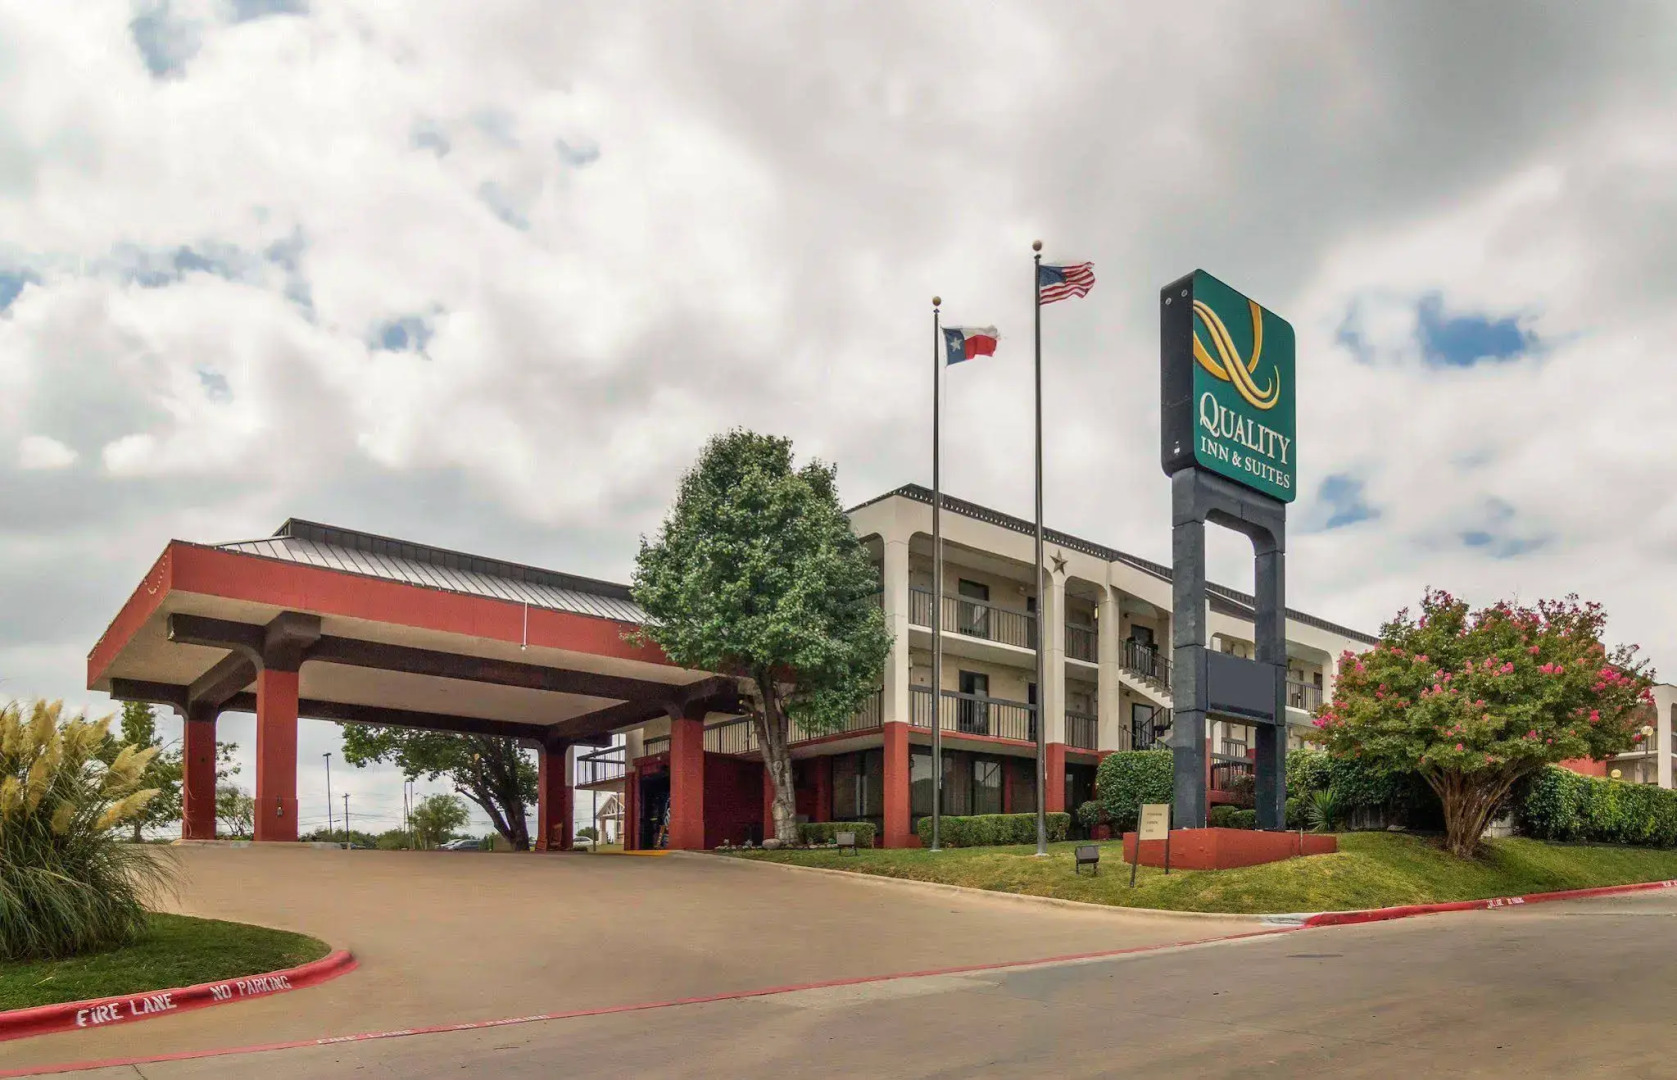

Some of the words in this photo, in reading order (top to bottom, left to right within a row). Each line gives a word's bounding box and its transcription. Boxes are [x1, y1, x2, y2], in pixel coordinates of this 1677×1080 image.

[1199, 391, 1291, 465] QUALITY
[1200, 435, 1230, 463] INN
[1231, 450, 1243, 468] &
[1244, 456, 1291, 489] SUITES
[76, 1002, 124, 1027] FIRE
[129, 993, 178, 1016] LANE
[209, 984, 233, 1001] NO
[235, 975, 292, 997] PARKING
